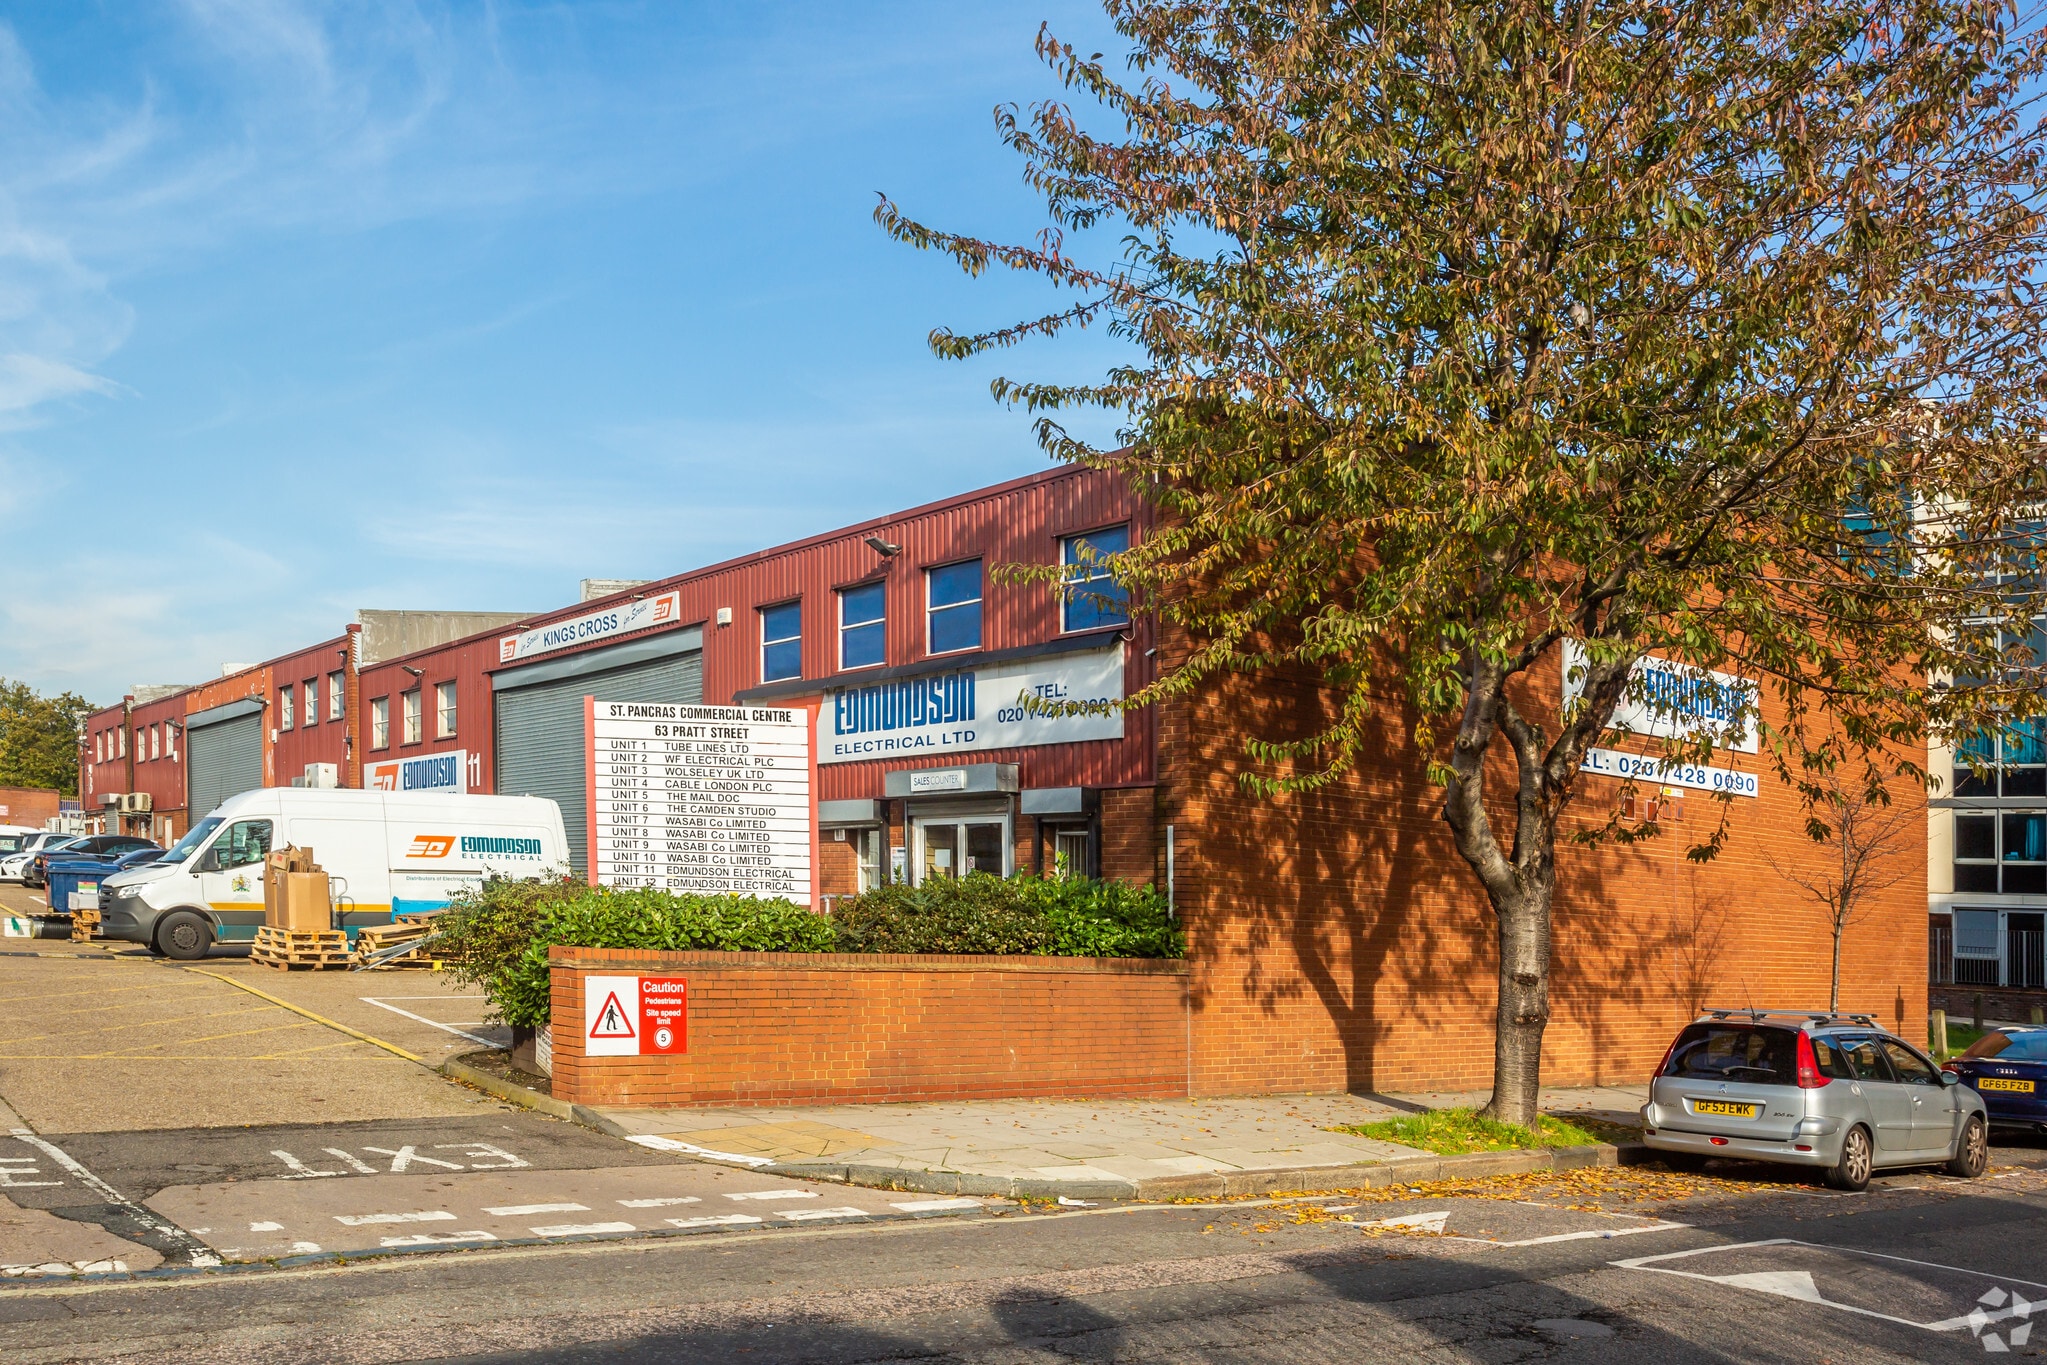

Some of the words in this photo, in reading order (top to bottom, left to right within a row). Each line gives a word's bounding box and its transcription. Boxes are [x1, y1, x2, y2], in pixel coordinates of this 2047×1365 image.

[543, 625, 576, 647] KINGS
[578, 613, 618, 638] CROSS
[1035, 683, 1068, 698] TEL:
[835, 671, 976, 736] EDMUNDSON
[610, 704, 626, 717] ST.
[627, 706, 676, 719] PANCRAS
[680, 707, 749, 721] COMMERCIAL
[752, 709, 792, 723] CENTRE
[997, 707, 1024, 723] 020
[654, 724, 669, 737] 63
[672, 725, 707, 738] PRATT
[710, 726, 750, 739] STREET
[610, 740, 637, 750] UNIT
[642, 741, 646, 750] 1
[664, 742, 693, 752] TUBE
[696, 743, 727, 753] LINES
[730, 744, 749, 754] LTD
[834, 734, 936, 755] ELECTRICAL
[942, 730, 976, 745] LTD
[611, 753, 638, 762] UNIT
[642, 753, 648, 763] 2
[664, 754, 681, 764] WF
[685, 755, 751, 766] ELECTRICAL
[754, 757, 774, 767] PLC
[403, 756, 457, 790] EDMUNDSON
[467, 752, 480, 787] 11
[611, 765, 638, 775] UNIT
[642, 766, 648, 775] 3
[664, 767, 723, 778] WOLSELEY
[727, 769, 742, 778] UK
[745, 770, 764, 779] LTD
[1619, 757, 1654, 777] 020
[1713, 772, 1755, 792] 0090
[611, 777, 638, 787] UNIT
[641, 779, 648, 787] 4
[664, 779, 700, 790] CABLE
[704, 781, 749, 791] LONDON
[752, 782, 773, 792] PLC
[913, 776, 930, 786] SALES
[930, 774, 959, 785] COUNTER
[611, 790, 638, 799] UNIT
[642, 790, 649, 800] 5
[666, 792, 687, 801] THE
[690, 792, 715, 802] MAIL
[717, 793, 740, 803] DOC
[612, 802, 639, 812] UNIT
[642, 803, 649, 813] 6
[667, 804, 687, 813] THE
[690, 805, 735, 815] CAMDEN
[737, 806, 776, 817] STUDIO
[612, 815, 639, 824] UNIT
[642, 816, 649, 824] 7
[665, 816, 707, 827] WASABI
[709, 818, 723, 827] Co
[726, 819, 767, 829] LIMITED
[612, 827, 638, 837] UNIT
[642, 828, 649, 837] 8
[665, 829, 707, 839] WASABI
[710, 830, 725, 840] Co
[728, 831, 770, 842] LIMITED
[460, 836, 542, 855] EDMUNDSON
[612, 839, 639, 849] UNIT
[642, 840, 649, 850] 9
[666, 841, 708, 851] WASABI
[711, 842, 726, 852] Co
[729, 843, 771, 854] LIMITED
[461, 852, 542, 862] ELECTRICAL
[613, 852, 640, 861] UNIT
[644, 853, 656, 862] 10
[667, 853, 708, 864] WASABI
[712, 855, 726, 864] Co
[729, 856, 772, 866] LIMITED
[613, 864, 640, 873] UNIT
[644, 865, 655, 874] 11
[666, 865, 730, 877] EDMUNDSON
[733, 868, 795, 879] ELECTRICAL
[613, 876, 640, 886] UNIT
[644, 877, 657, 888] 12
[666, 878, 730, 889] EDMUNDSON
[733, 880, 795, 891] ELECTRICAL
[642, 981, 684, 993] Caution
[656, 1017, 671, 1025] limit
[660, 1009, 681, 1018] speed
[660, 1033, 667, 1042] 5
[1982, 1079, 2008, 1088] GF65
[2009, 1081, 2030, 1090] FZB
[1698, 1101, 1726, 1112] GF53
[1728, 1104, 1751, 1115] EWK
[269, 1143, 533, 1180] EXIT
